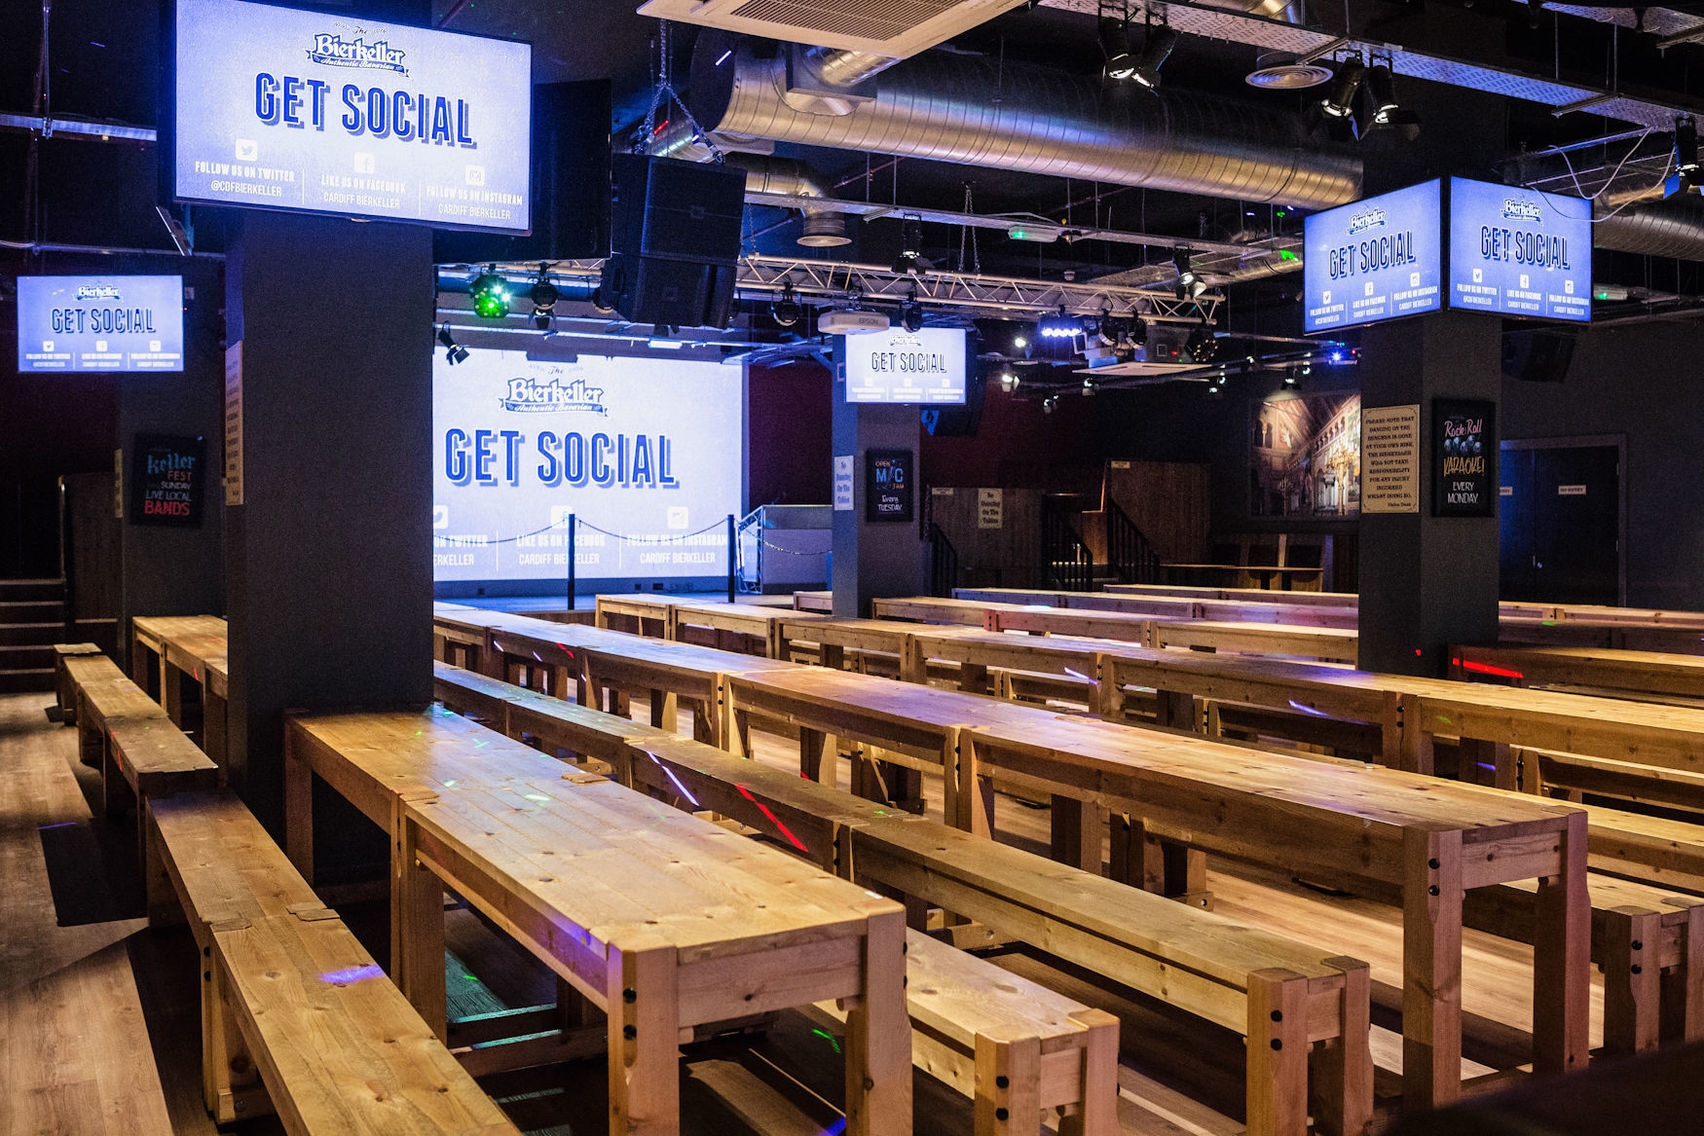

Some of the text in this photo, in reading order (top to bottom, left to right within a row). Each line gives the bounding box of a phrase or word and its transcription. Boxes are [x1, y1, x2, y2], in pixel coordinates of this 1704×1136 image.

[315, 33, 405, 64] Bierkeller
[255, 72, 477, 149] GET SOCIAL
[195, 161, 295, 182] FOLLOW US ON TWITTER
[211, 180, 282, 197] @CDFBIERKELLER
[321, 174, 340, 187] LIKE
[366, 178, 406, 193] FACEBOOK
[323, 192, 400, 208] CARDIFF BIERKELLER
[426, 185, 456, 198] FOLLOW
[482, 190, 523, 205] INSTAGRAM
[438, 203, 511, 220] CARDIFF BIERKELLER
[1329, 229, 1416, 280] GET SOCIAL
[1481, 226, 1571, 270] GET SOCIAL
[51, 308, 156, 334] GET SOCIAL
[871, 351, 948, 374] GET SOCIAL
[508, 378, 604, 403] Bierkeller
[1466, 418, 1483, 435] Roll
[445, 428, 679, 488] GET SOCIAL
[1443, 456, 1485, 477] KARAOKE!
[167, 470, 192, 482] FEST
[1452, 481, 1475, 491] EVERY
[165, 490, 192, 502] LOCAL
[143, 500, 191, 516] BANDS
[640, 552, 671, 564] CARDIFF
